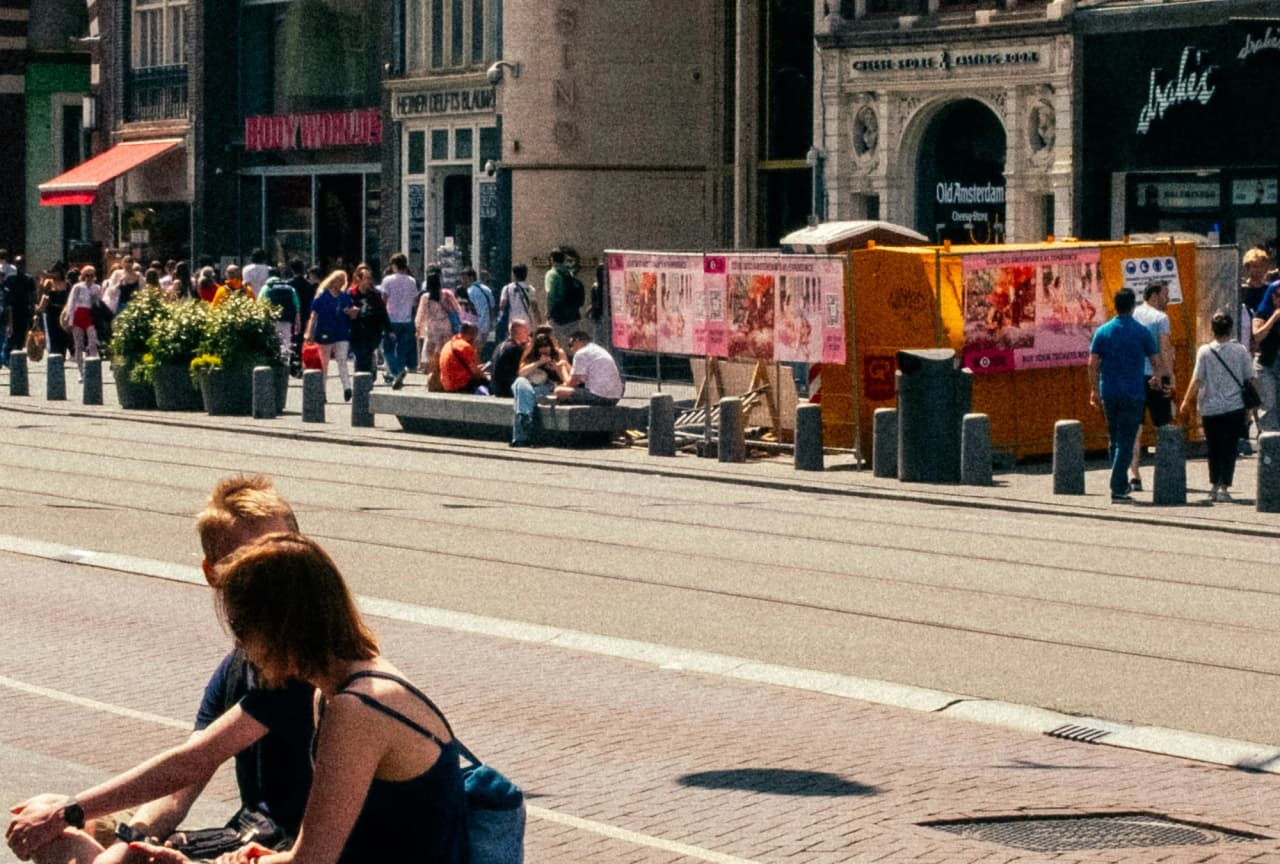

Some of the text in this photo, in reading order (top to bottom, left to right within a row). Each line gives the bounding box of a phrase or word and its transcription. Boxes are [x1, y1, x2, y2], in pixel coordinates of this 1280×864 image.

[898, 57, 935, 70] STORE
[429, 91, 460, 112] DELFTS
[245, 107, 383, 151] BODY WORLDS
[936, 182, 1005, 203] Old Amsterdam
